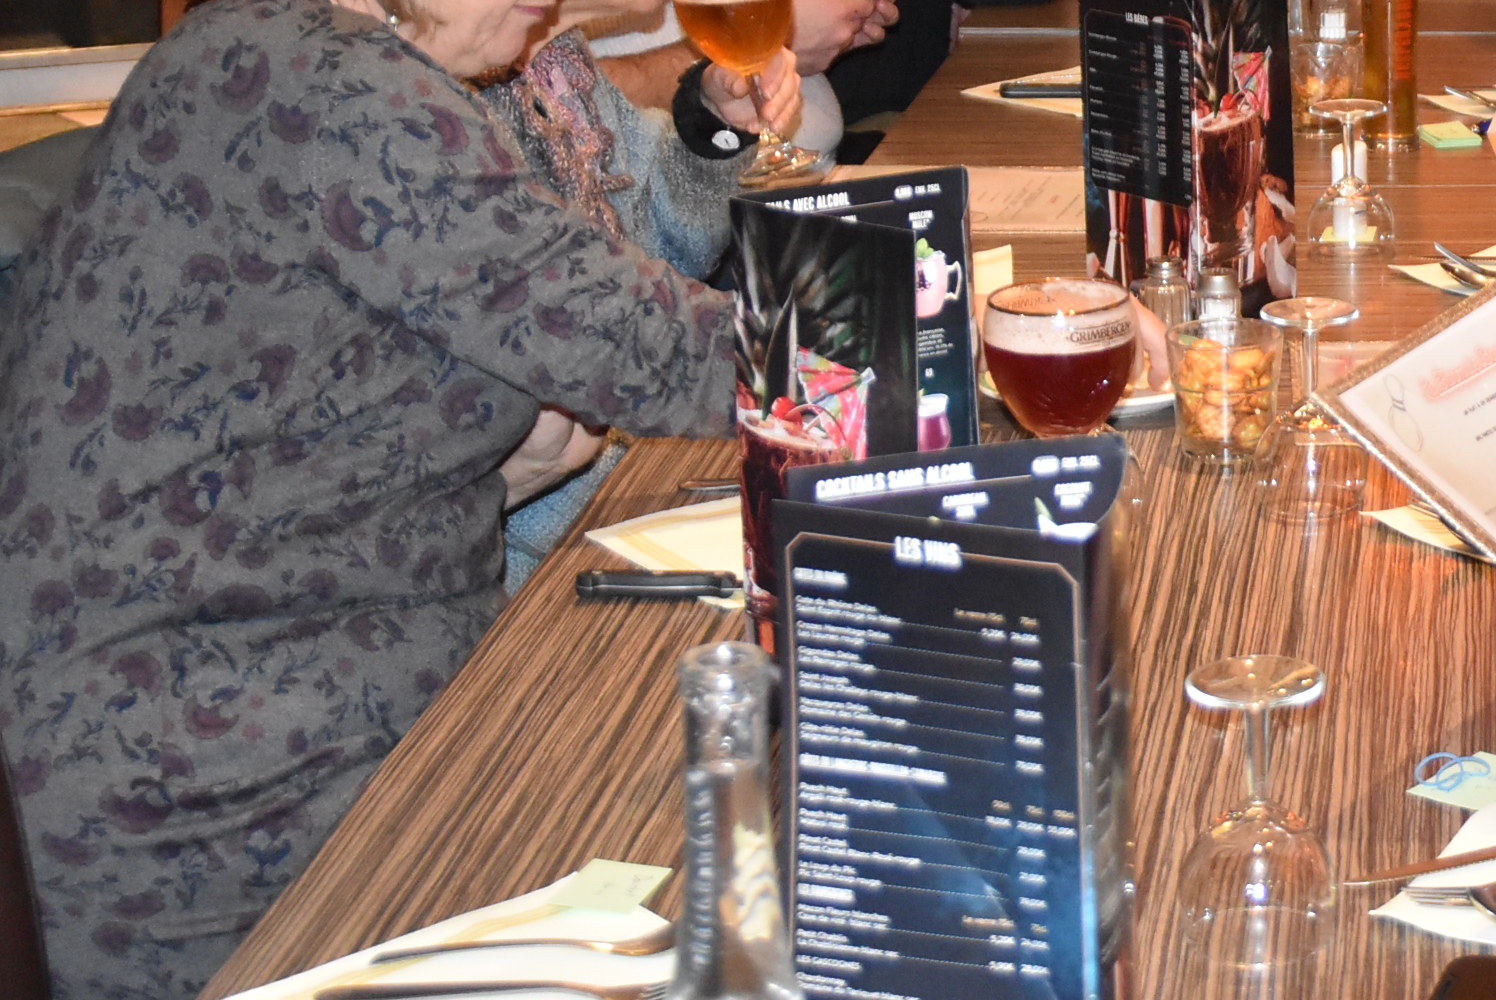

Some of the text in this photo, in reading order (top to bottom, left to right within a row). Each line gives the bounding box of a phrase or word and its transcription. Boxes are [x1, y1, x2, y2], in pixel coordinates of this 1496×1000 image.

[792, 195, 815, 212] AVEC
[816, 191, 850, 208] ALCOOL
[1069, 320, 1132, 344] GRIMBERGEN
[815, 471, 886, 502] COCKTAILS
[887, 466, 925, 491] SANS
[925, 461, 975, 486] ALCOOL
[894, 535, 963, 570] LES VINS
